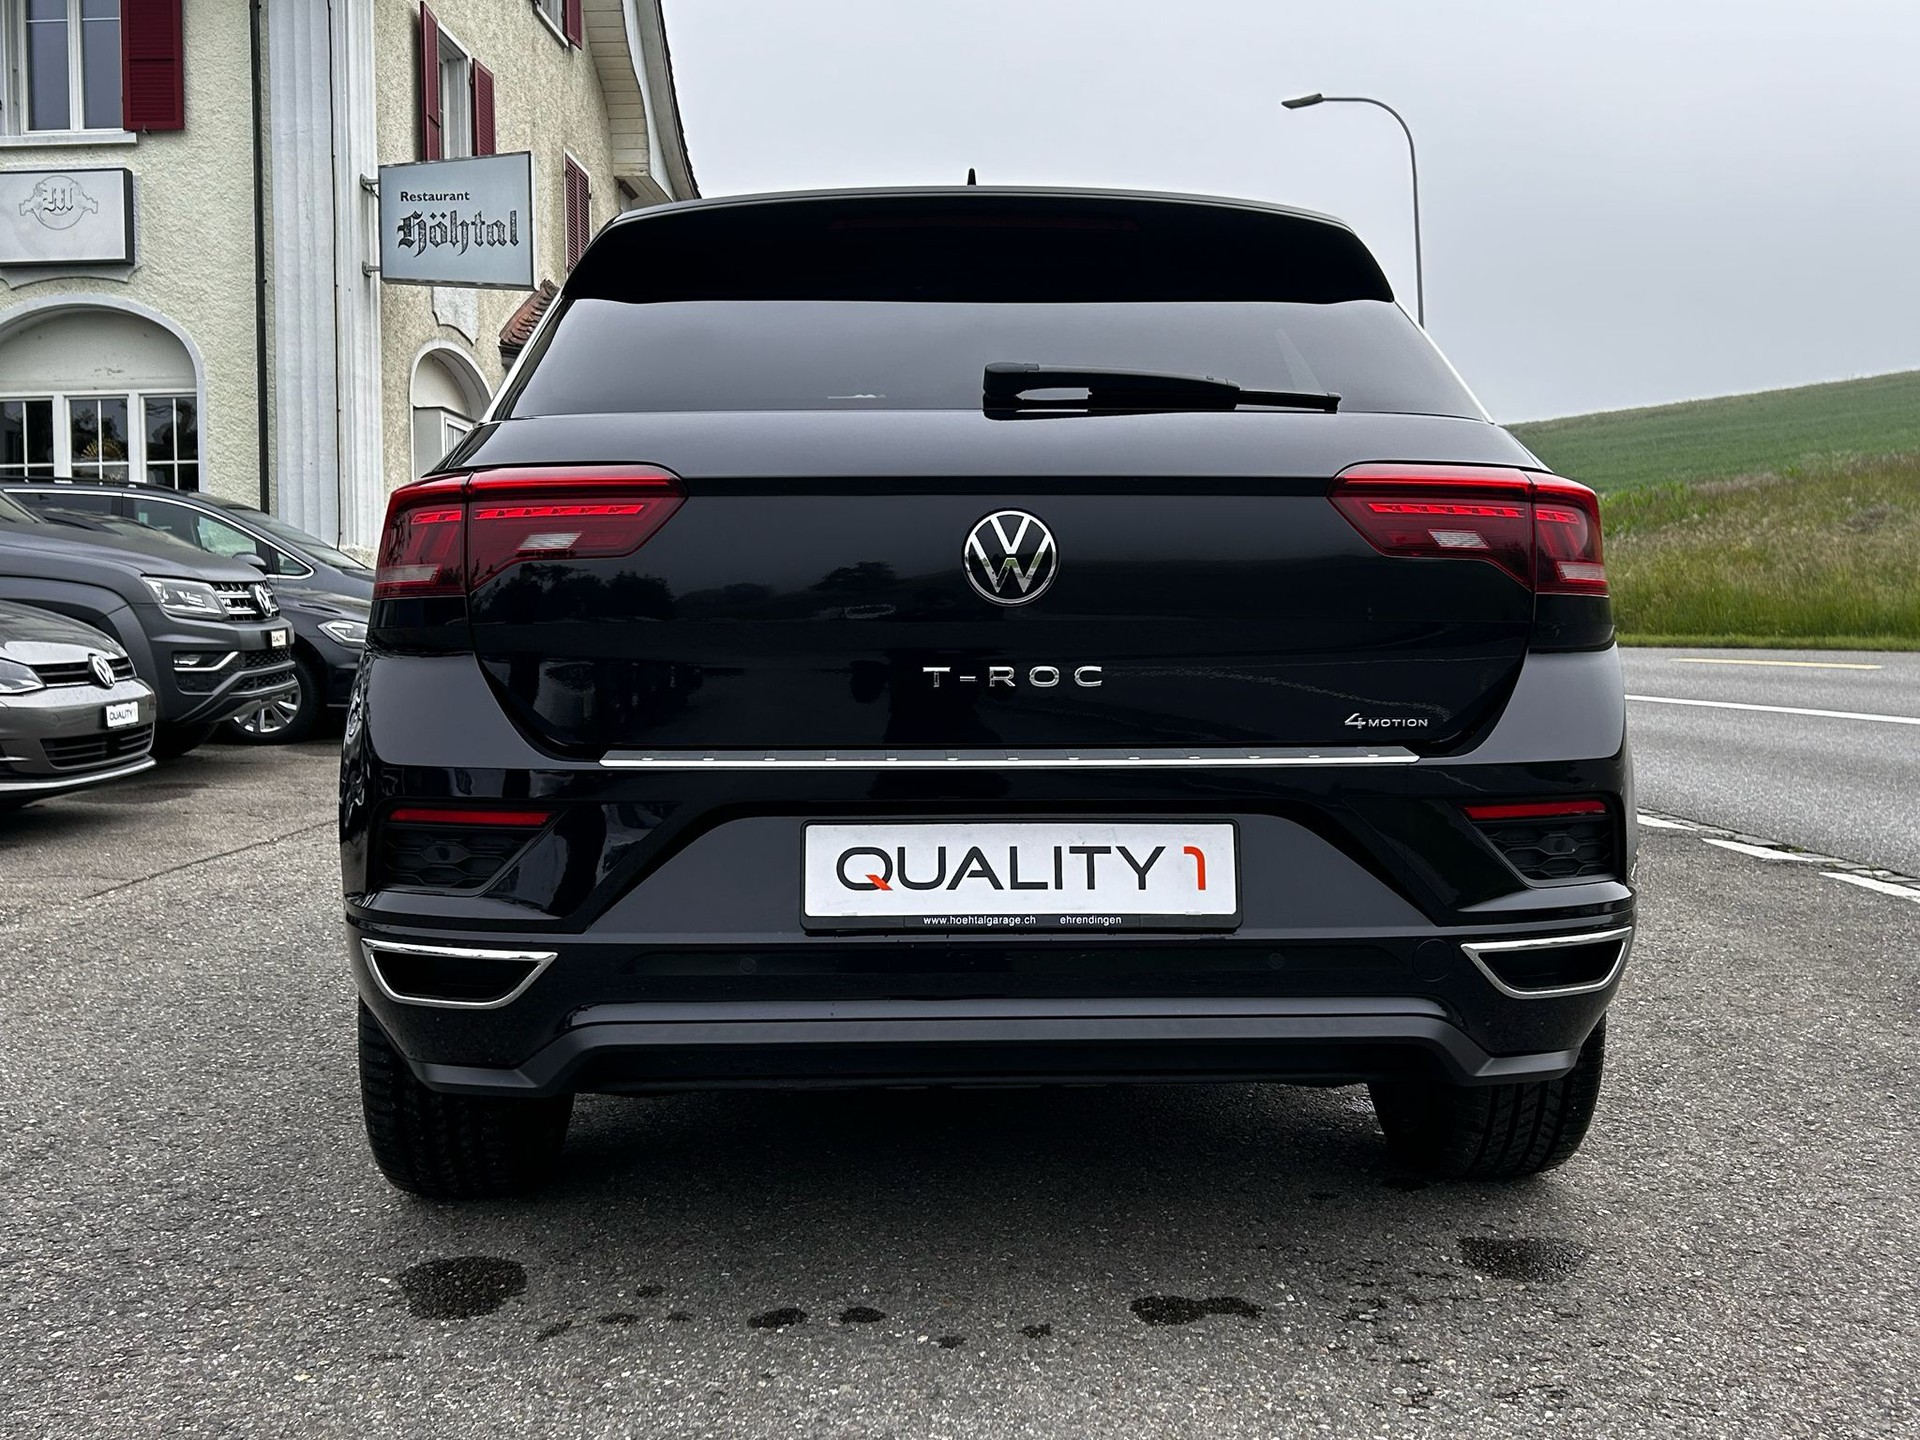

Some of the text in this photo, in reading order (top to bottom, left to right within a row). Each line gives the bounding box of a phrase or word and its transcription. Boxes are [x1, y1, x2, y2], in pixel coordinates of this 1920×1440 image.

[400, 191, 470, 202] Restaurant
[397, 210, 520, 258] Höhtal
[922, 665, 1103, 688] T-ROC
[1344, 712, 1429, 730] 4MOTION
[836, 846, 1206, 891] QUALITY 1
[923, 915, 1122, 927] www.hoehtalgarage.ch ehrendingen
